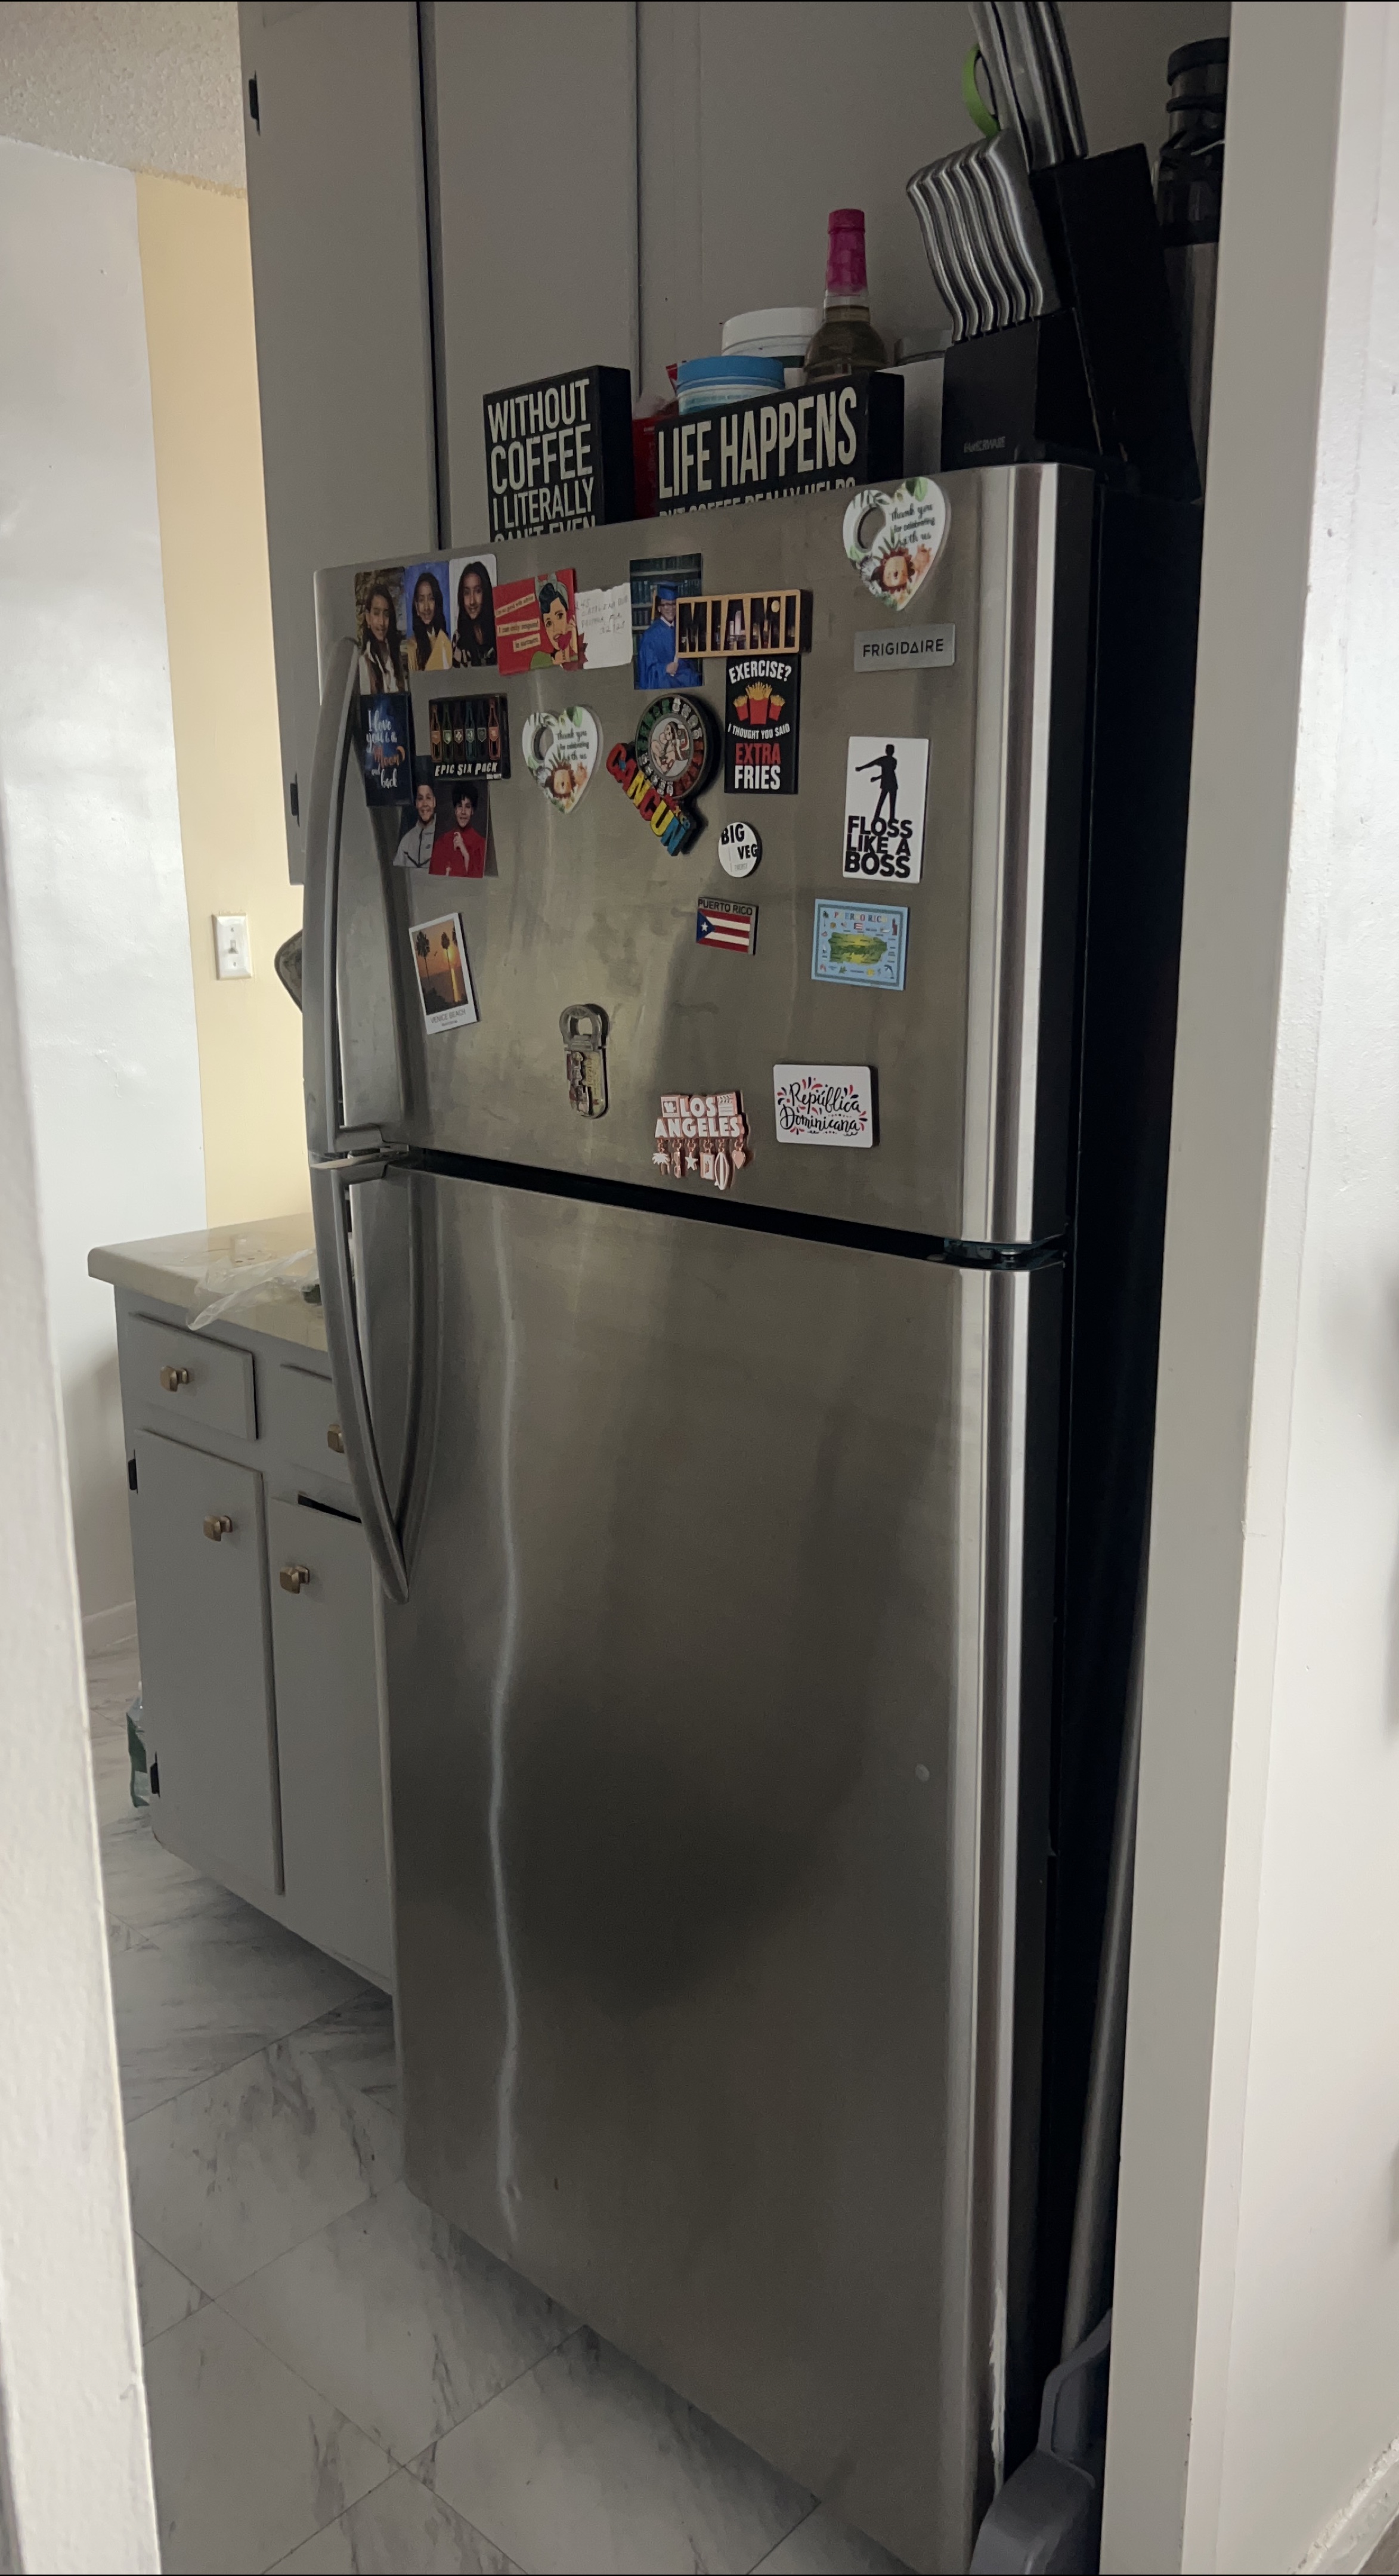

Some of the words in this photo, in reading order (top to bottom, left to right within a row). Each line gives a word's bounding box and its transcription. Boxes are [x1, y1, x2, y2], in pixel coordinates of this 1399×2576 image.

[487, 379, 590, 444] WITHOUT
[658, 420, 712, 499] LIFE
[720, 387, 857, 488] HAPPENS
[491, 423, 593, 494] COFFEE
[493, 497, 499, 531] I
[503, 477, 595, 529] LITERALLY
[677, 595, 797, 653] MIAMI
[863, 638, 944, 658] FRIGIDAIRE
[728, 660, 792, 685] EXERCISE?
[728, 723, 732, 732] I
[732, 724, 759, 740] THOUGHT
[760, 727, 773, 740] YOU
[775, 723, 790, 738] SAID
[735, 743, 781, 764] EXTRA
[435, 764, 454, 777] EPIC
[457, 763, 472, 776] SIX
[475, 762, 498, 775] PACK
[734, 765, 781, 790] FRIES
[606, 743, 686, 856] CANCUN
[721, 823, 745, 845] BIG
[848, 815, 912, 839] FLOSS
[737, 844, 758, 860] VEG
[847, 834, 888, 854] LIKE
[896, 838, 911, 856] A
[844, 851, 910, 878] BOSS
[698, 899, 731, 912] PUERTO
[732, 905, 753, 916] RICO
[679, 1097, 717, 1117] LOS
[790, 1082, 861, 1114] República
[655, 1117, 740, 1138] ANGELES
[779, 1104, 861, 1131] Dominicana
